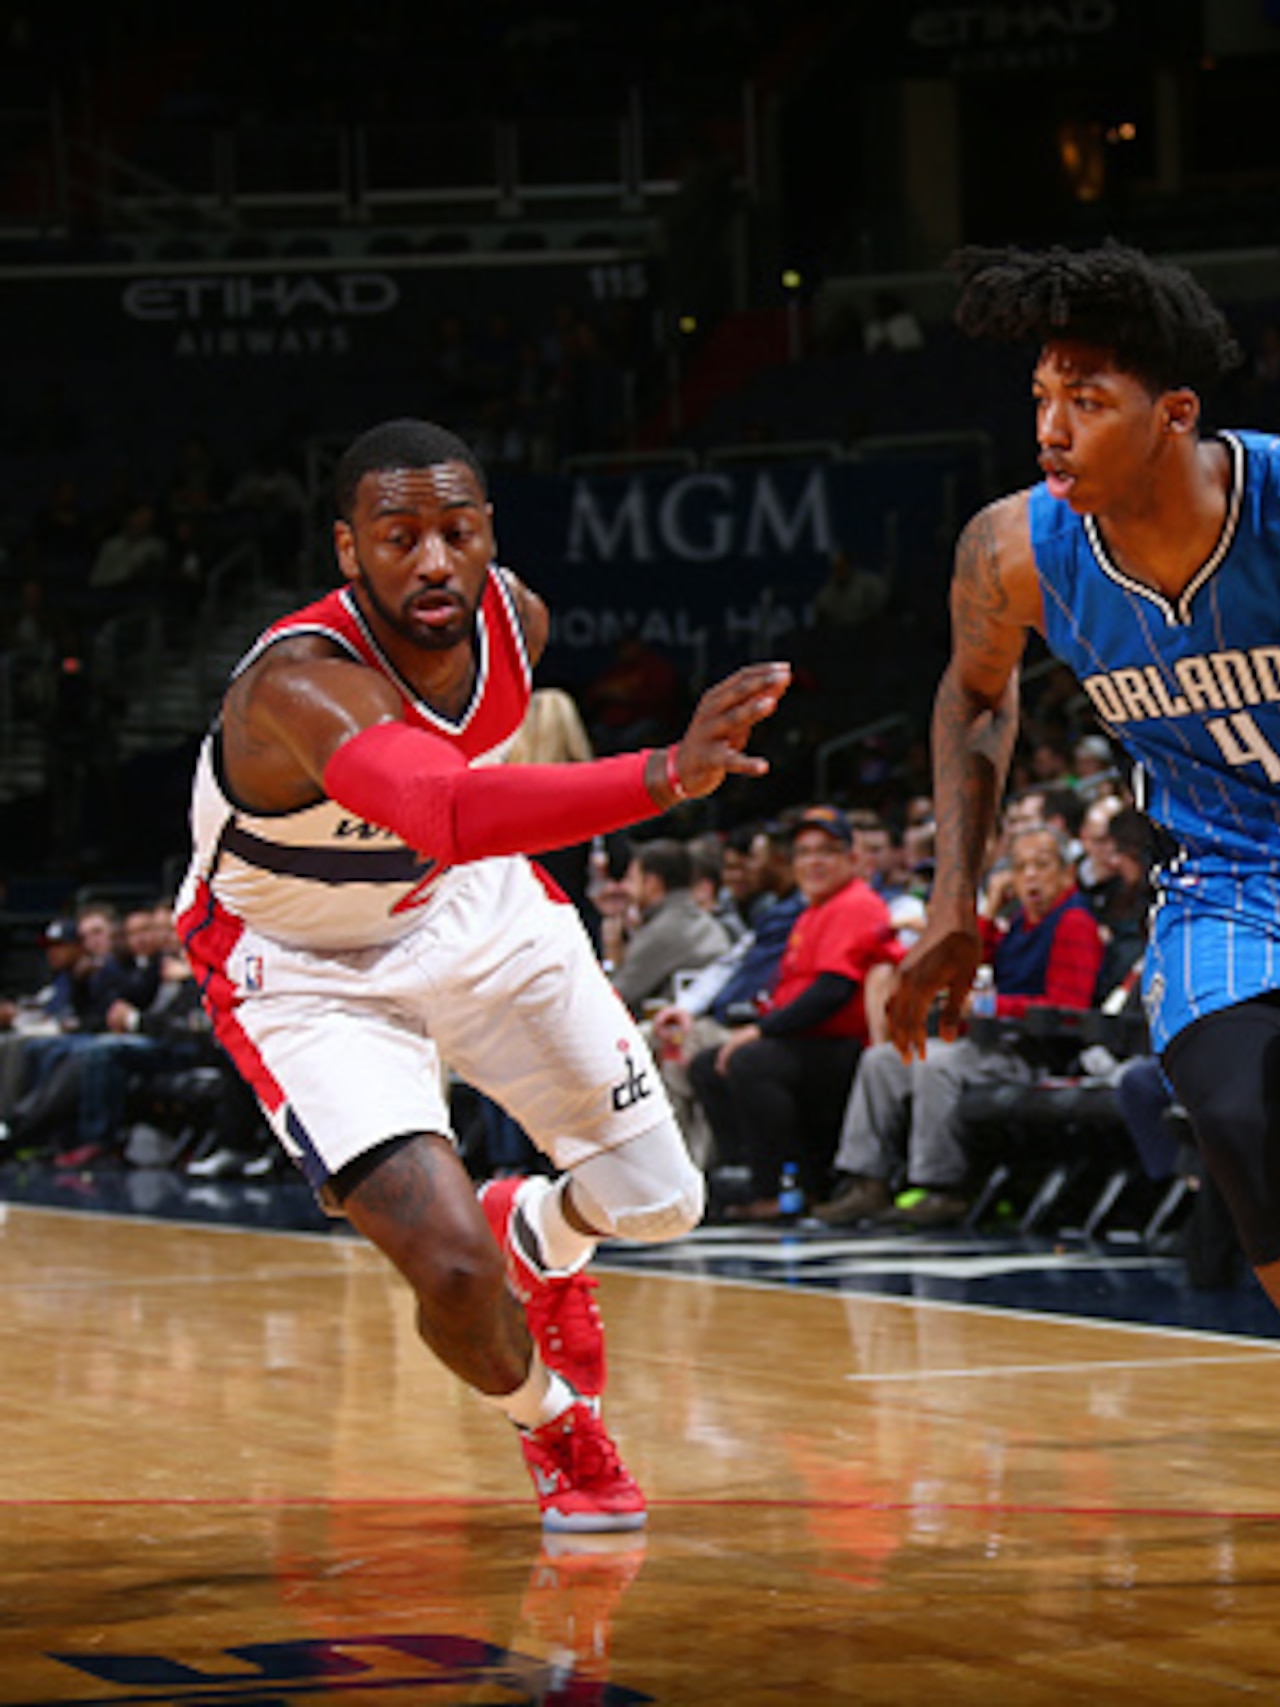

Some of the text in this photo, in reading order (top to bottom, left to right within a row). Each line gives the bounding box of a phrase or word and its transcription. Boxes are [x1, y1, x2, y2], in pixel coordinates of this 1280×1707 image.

[121, 273, 400, 320] ETIHAD
[587, 262, 648, 300] 115
[174, 325, 350, 355] AIRWAYS
[564, 467, 838, 564] MGM
